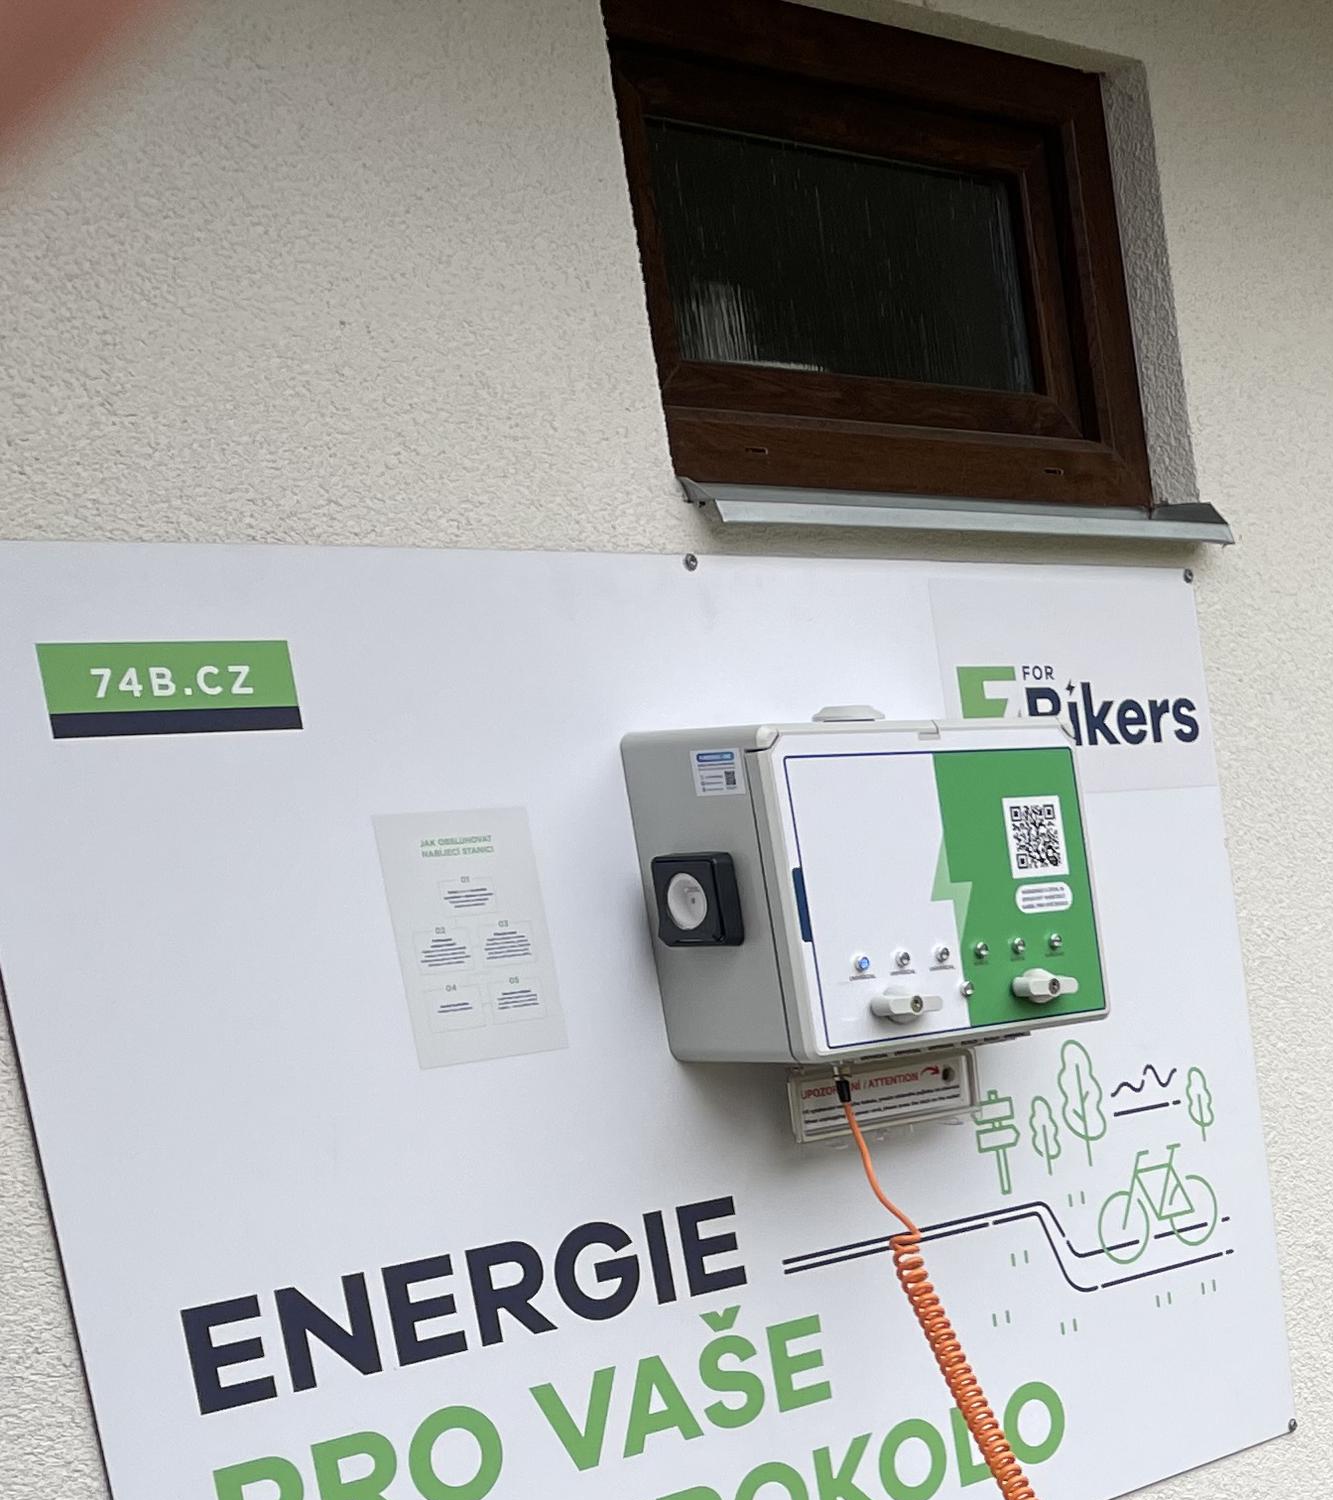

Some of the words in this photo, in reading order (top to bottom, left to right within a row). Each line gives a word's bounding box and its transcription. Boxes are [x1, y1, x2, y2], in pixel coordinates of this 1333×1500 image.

[90, 665, 254, 698] 74B.CZ
[1022, 665, 1055, 681] FOR
[445, 984, 457, 992] 04
[867, 1071, 919, 1088] ATTENTION
[181, 1195, 747, 1415] ENERGIE
[529, 1305, 832, 1472] VAŠE
